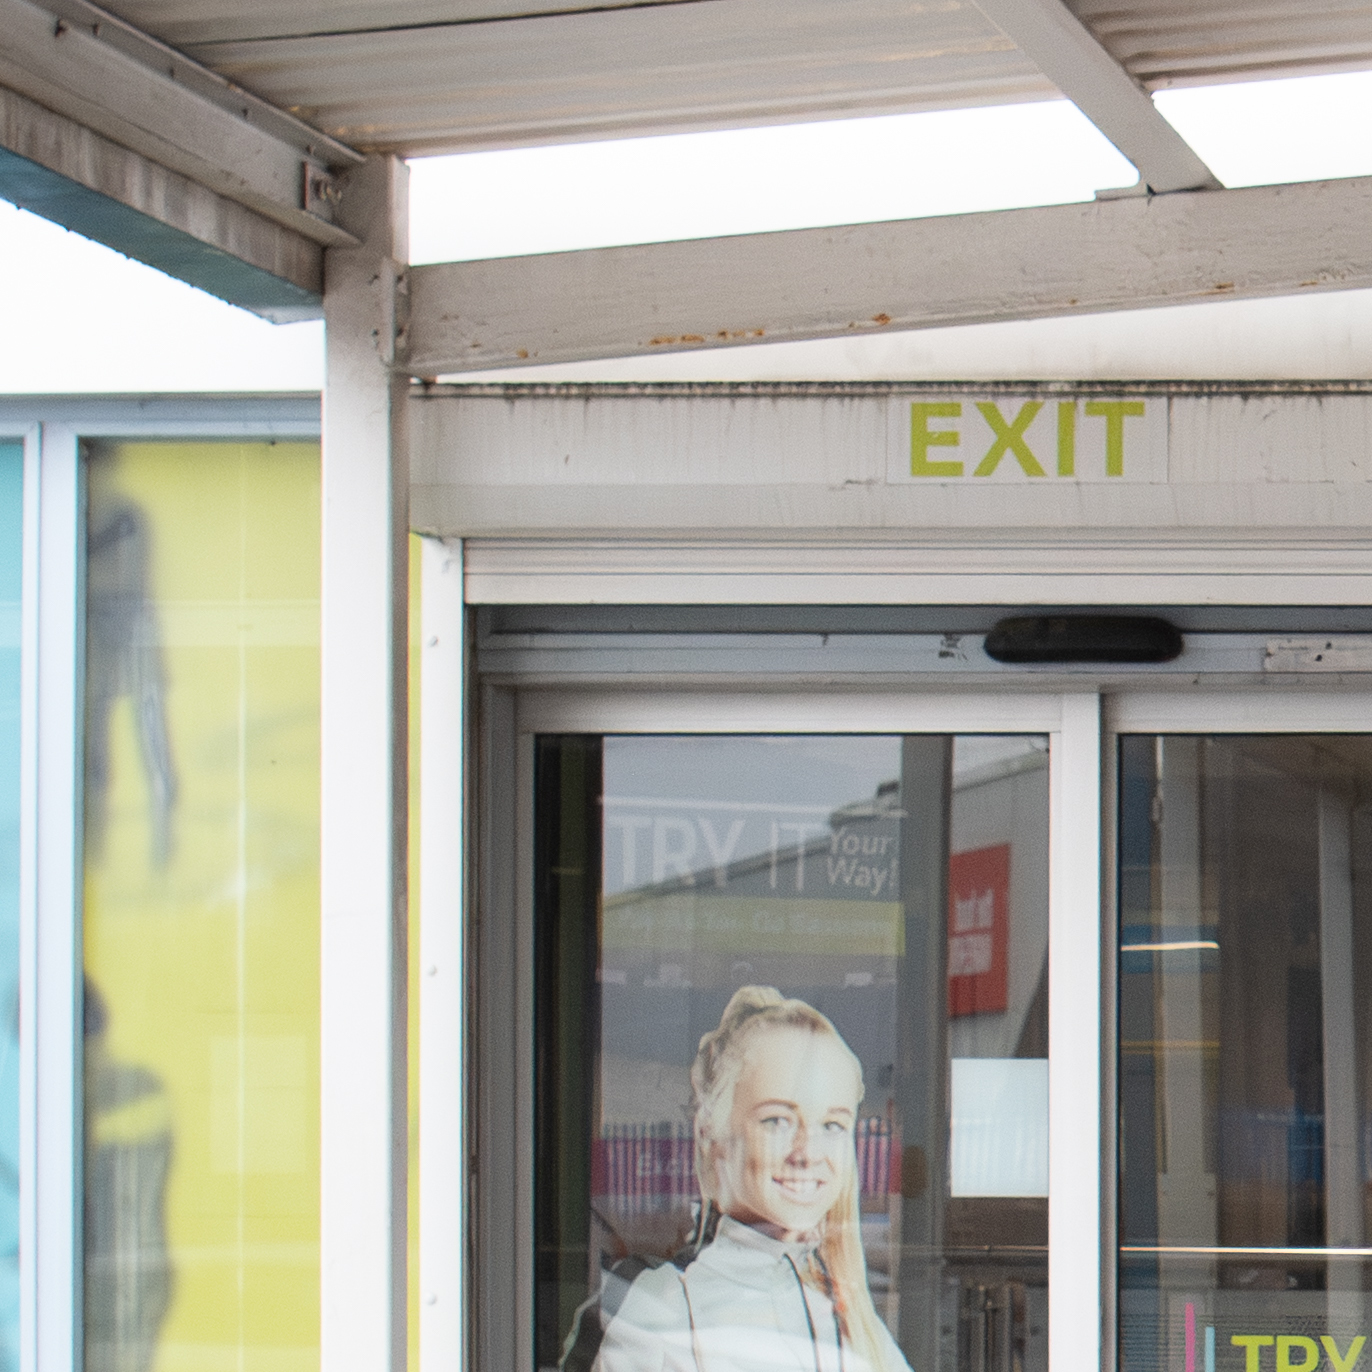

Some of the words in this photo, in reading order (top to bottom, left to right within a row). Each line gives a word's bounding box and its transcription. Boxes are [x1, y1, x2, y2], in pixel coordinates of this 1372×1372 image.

[911, 401, 1144, 478] EXIT
[607, 815, 746, 889] TRY
[769, 821, 824, 892] IT
[828, 824, 893, 856] Your
